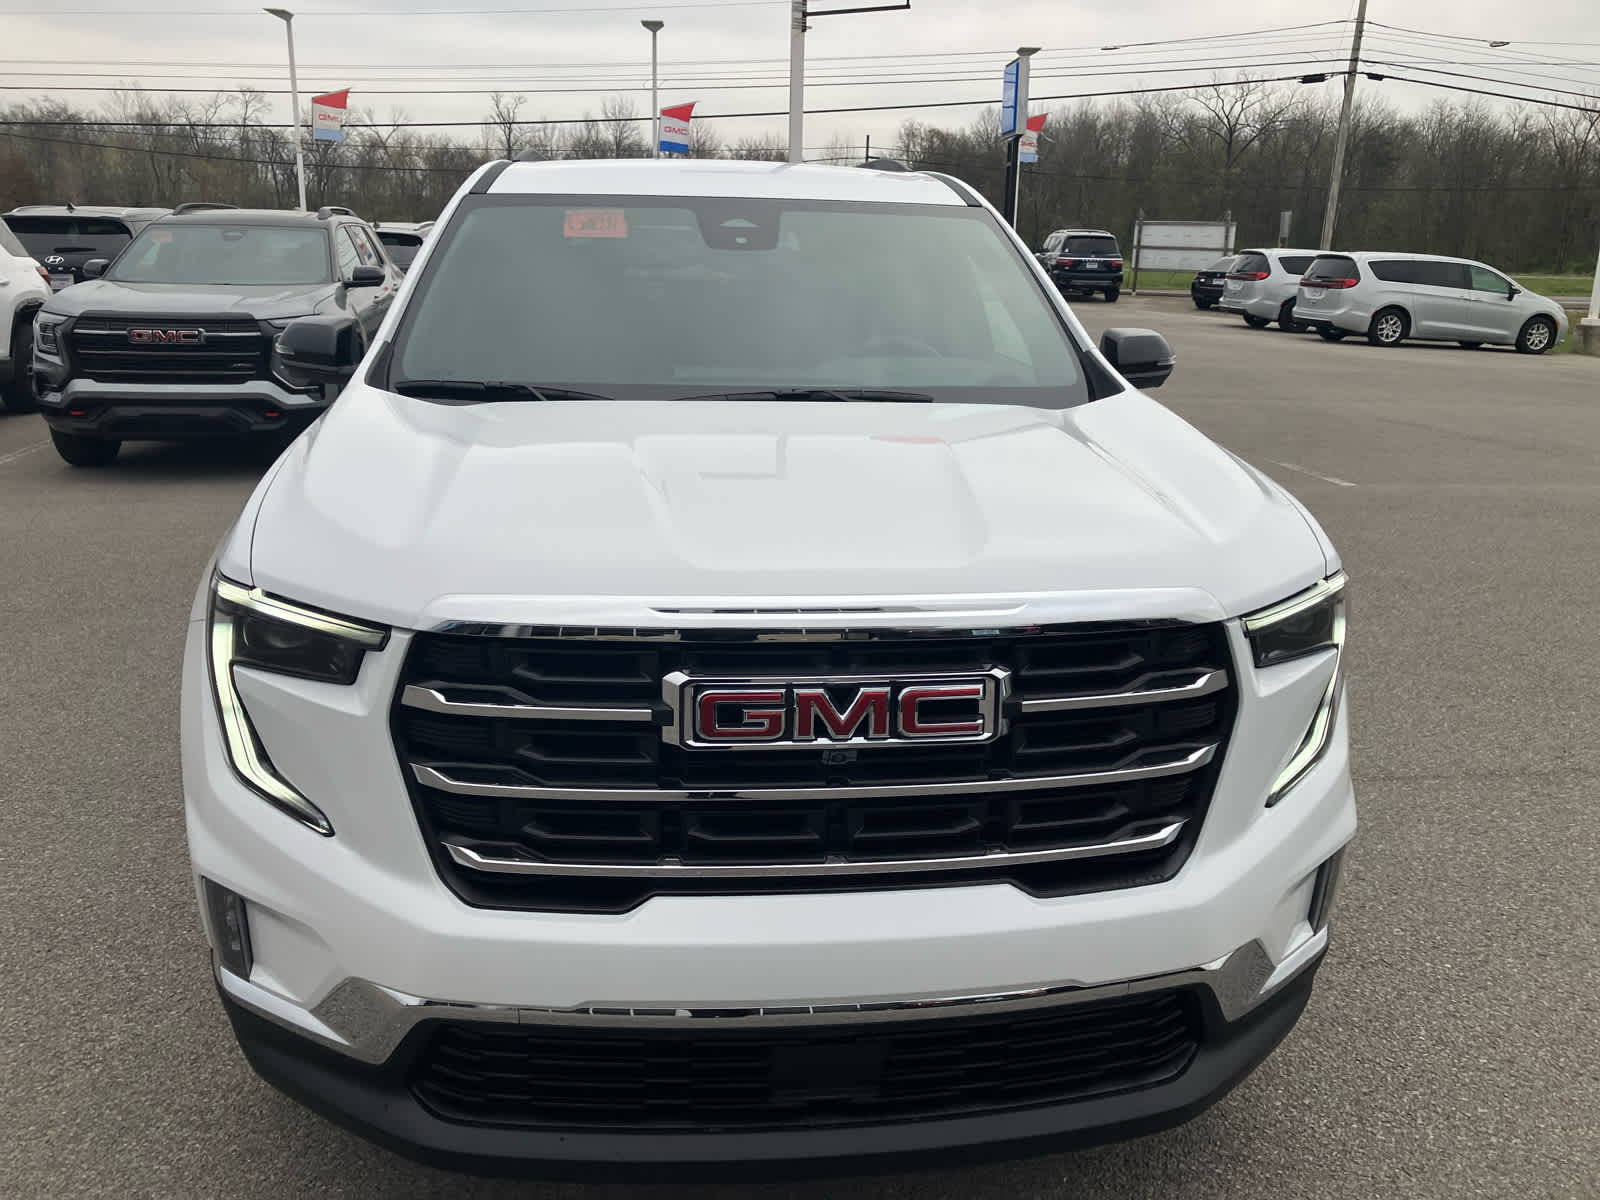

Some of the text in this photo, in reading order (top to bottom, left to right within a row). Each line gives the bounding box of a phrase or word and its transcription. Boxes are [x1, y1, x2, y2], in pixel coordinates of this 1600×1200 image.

[663, 126, 689, 136] GMC
[131, 329, 199, 343] GMC
[697, 684, 985, 740] GMC
